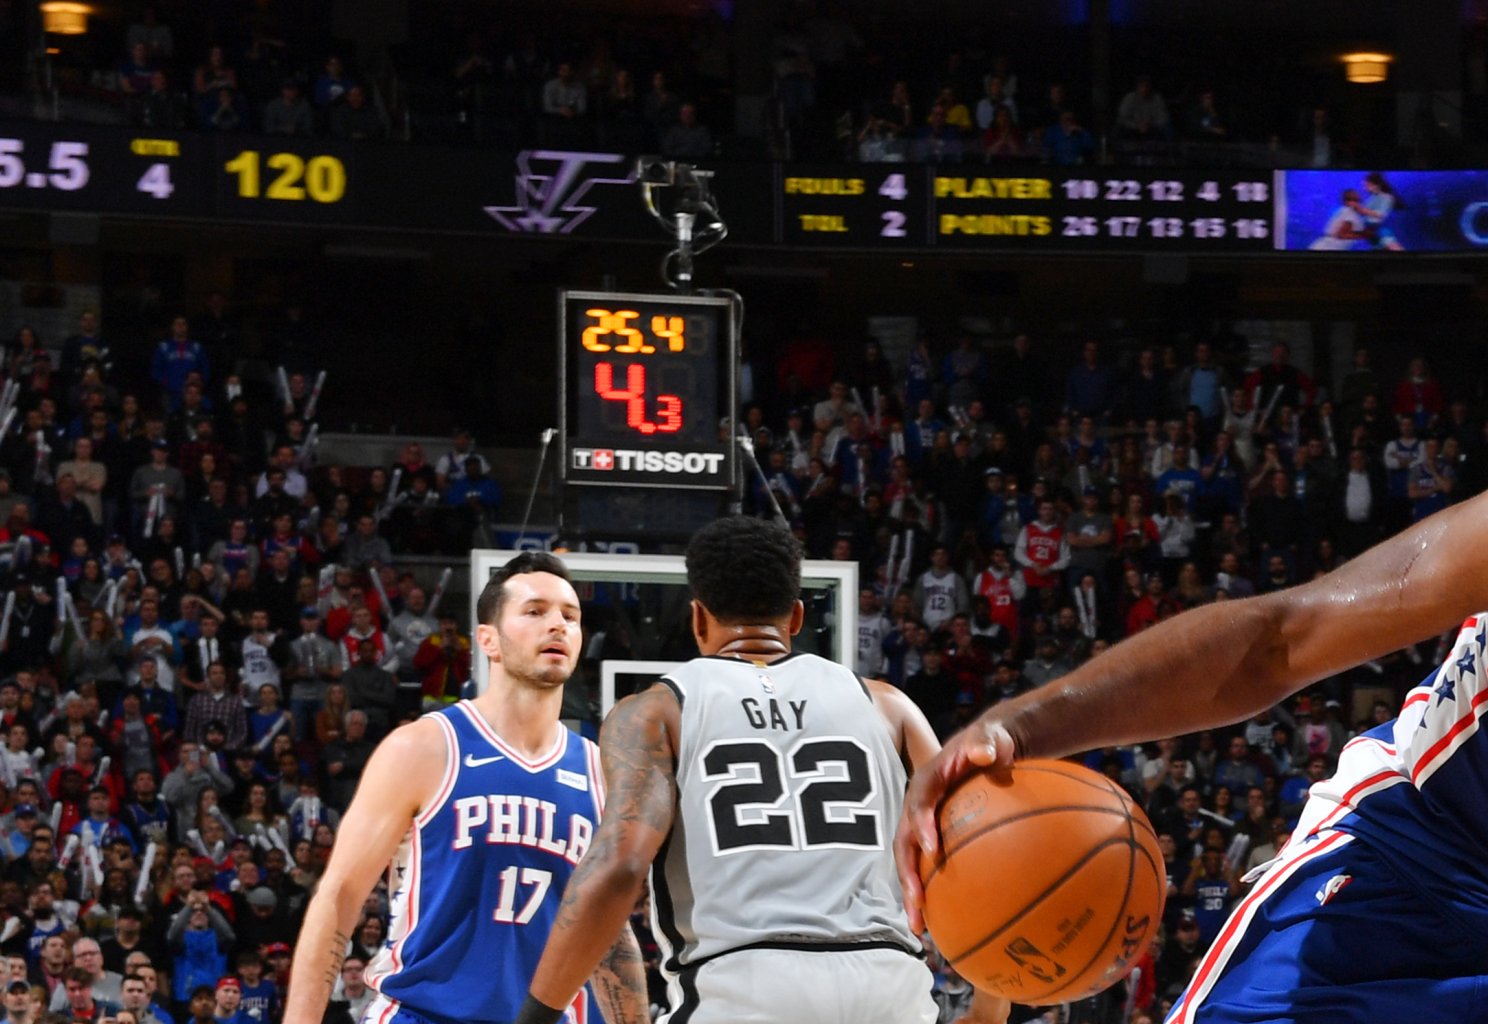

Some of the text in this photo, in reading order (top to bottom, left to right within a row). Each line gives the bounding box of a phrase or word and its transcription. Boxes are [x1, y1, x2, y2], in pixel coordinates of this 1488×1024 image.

[136, 163, 175, 198] 4
[224, 150, 346, 203] 120
[784, 174, 908, 200] FOULS 4
[933, 177, 1052, 199] PLAYER
[1104, 180, 1141, 201] 22
[1145, 181, 1184, 202] 12
[1196, 181, 1221, 202] 4
[879, 211, 907, 238] 2
[940, 214, 1052, 236] POINTS
[1104, 217, 1141, 237] 17
[582, 308, 685, 354] 25.4
[595, 362, 682, 434] 4.3
[615, 450, 725, 474] TISSOT
[741, 697, 808, 732] GAY
[698, 735, 885, 857] 22
[453, 794, 595, 867] PHILA
[493, 866, 552, 925] 17
